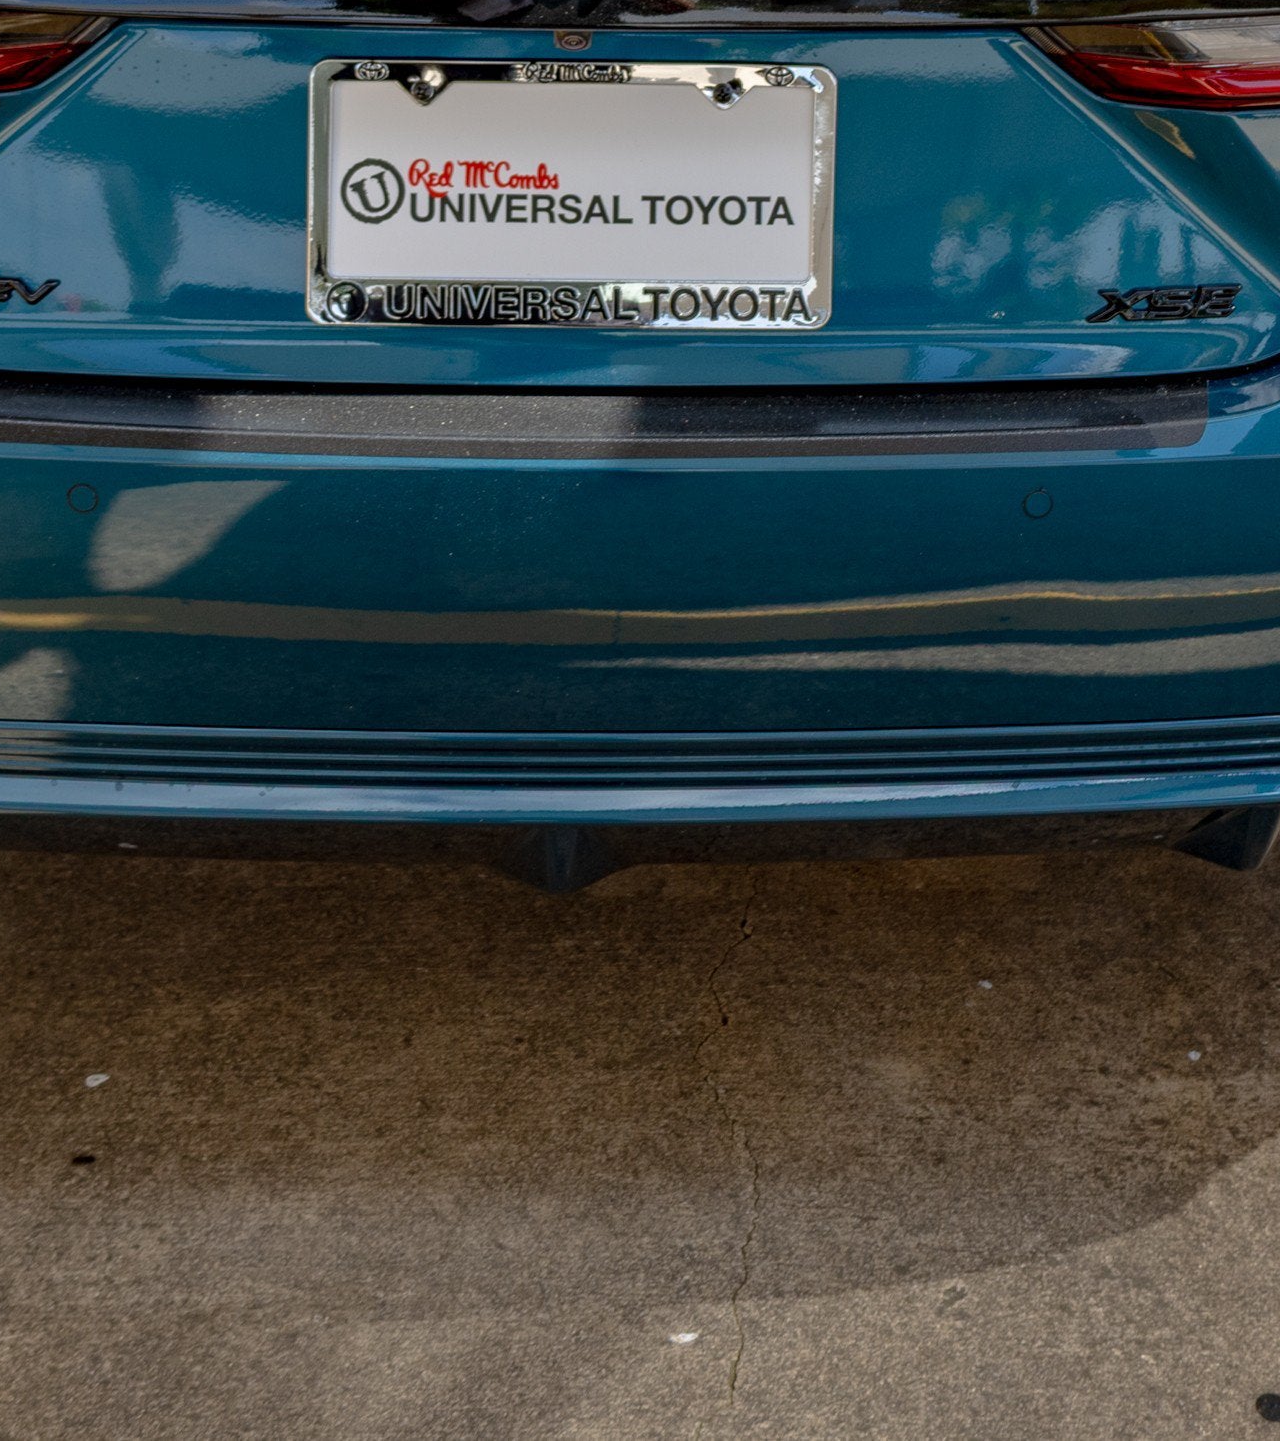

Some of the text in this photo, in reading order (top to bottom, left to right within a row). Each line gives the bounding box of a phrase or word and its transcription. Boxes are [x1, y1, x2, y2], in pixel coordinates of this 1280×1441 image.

[408, 158, 560, 198] Red McCombs
[409, 193, 795, 226] UNIVERSAL TOYOTA
[384, 283, 815, 323] UNIVERSAL TOYOTA
[1086, 282, 1243, 324] XSE
